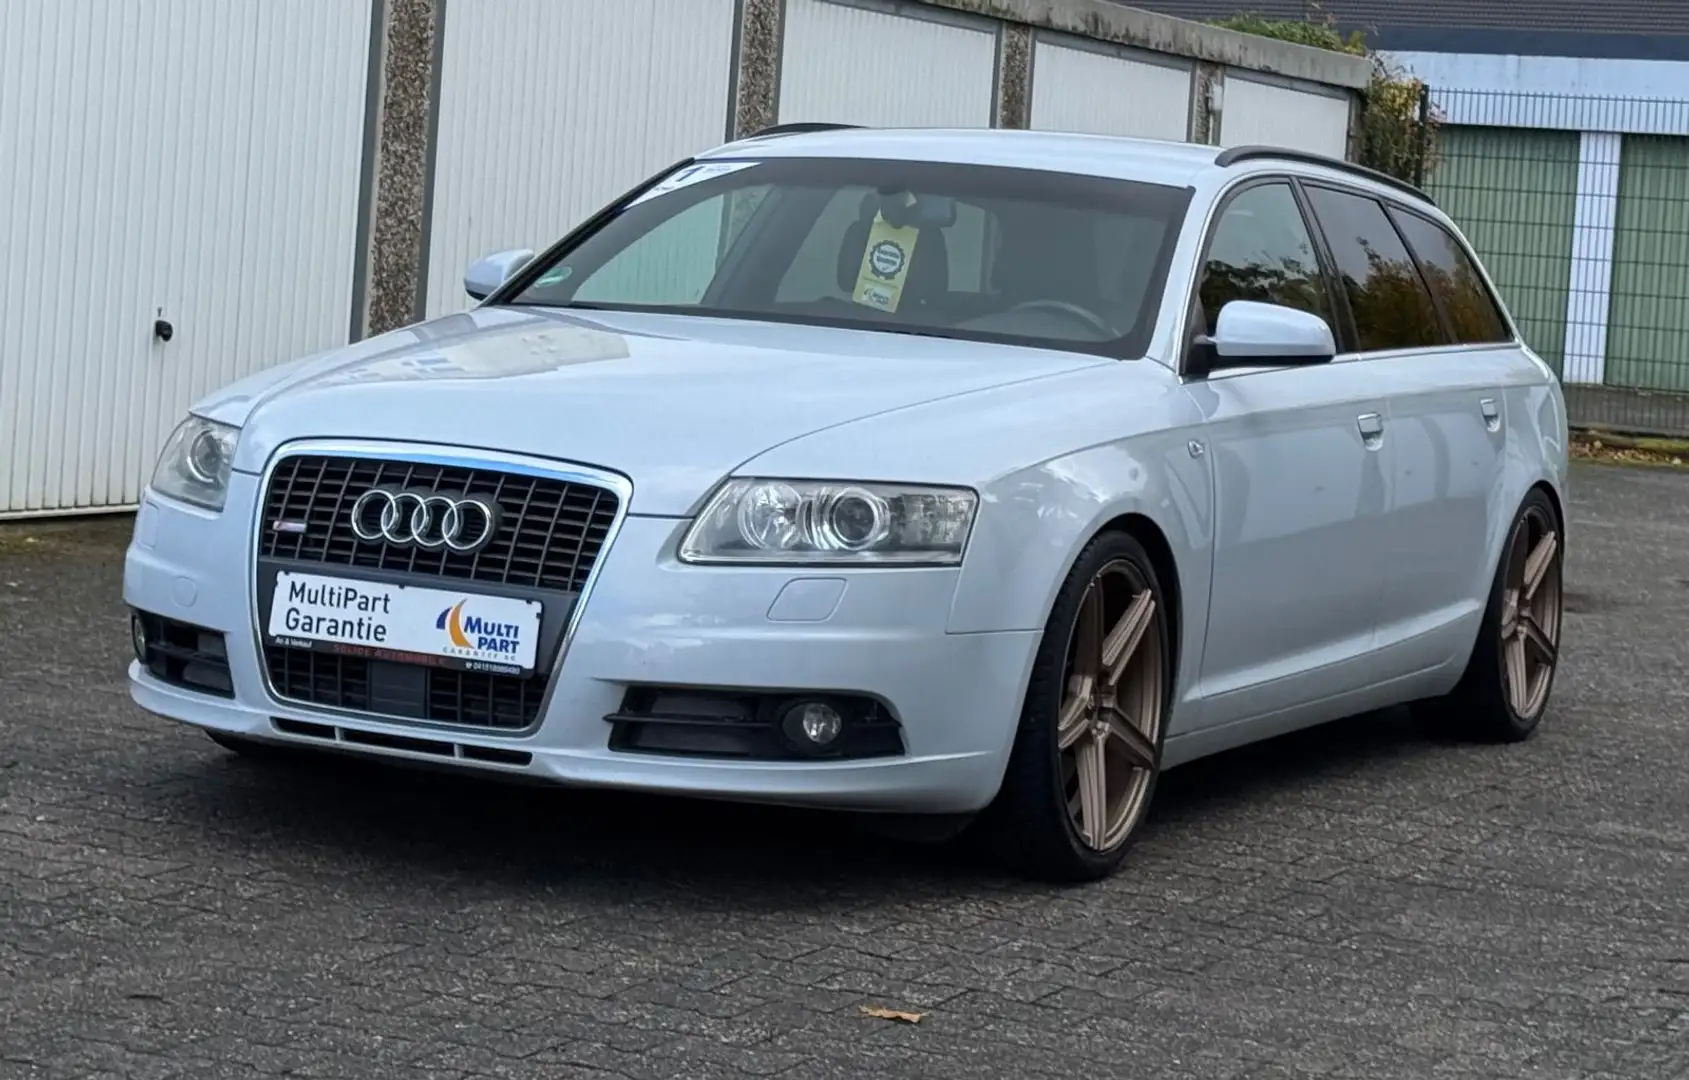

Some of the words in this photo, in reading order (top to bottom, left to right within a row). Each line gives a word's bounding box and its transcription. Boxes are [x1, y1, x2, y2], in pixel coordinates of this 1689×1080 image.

[289, 580, 391, 614] MultiPart
[285, 607, 386, 642] Garantie
[464, 616, 519, 639] MULTI
[477, 637, 519, 654] PART
